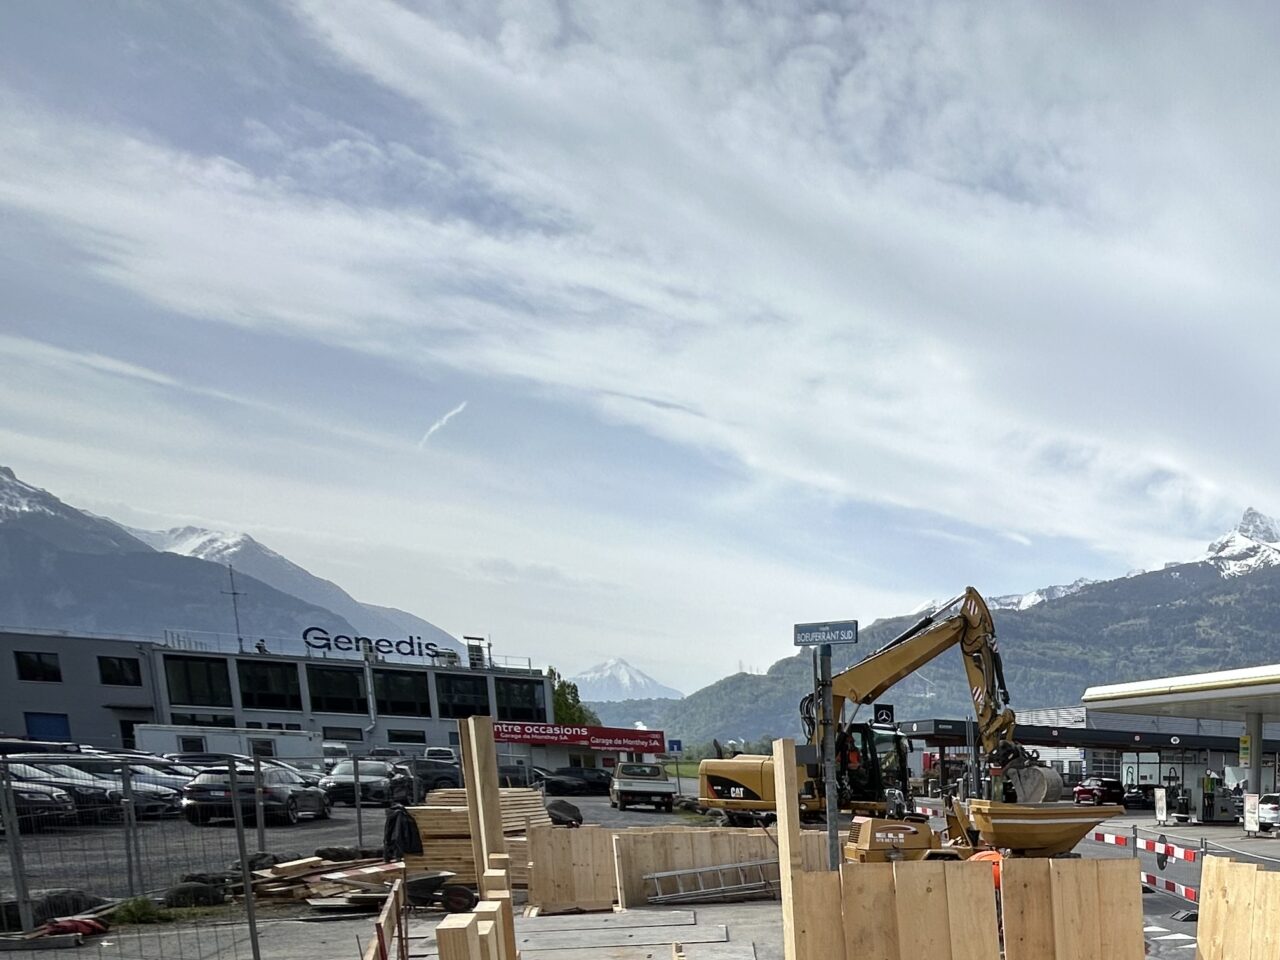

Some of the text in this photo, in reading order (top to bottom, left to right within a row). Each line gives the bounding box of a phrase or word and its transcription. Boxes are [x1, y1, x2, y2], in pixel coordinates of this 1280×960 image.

[840, 629, 853, 640] SUD
[302, 626, 440, 658] Genedis
[493, 724, 588, 735] ntre occasions
[590, 736, 613, 746] Garage
[623, 738, 648, 747] Monthey
[730, 787, 744, 798] CAT
